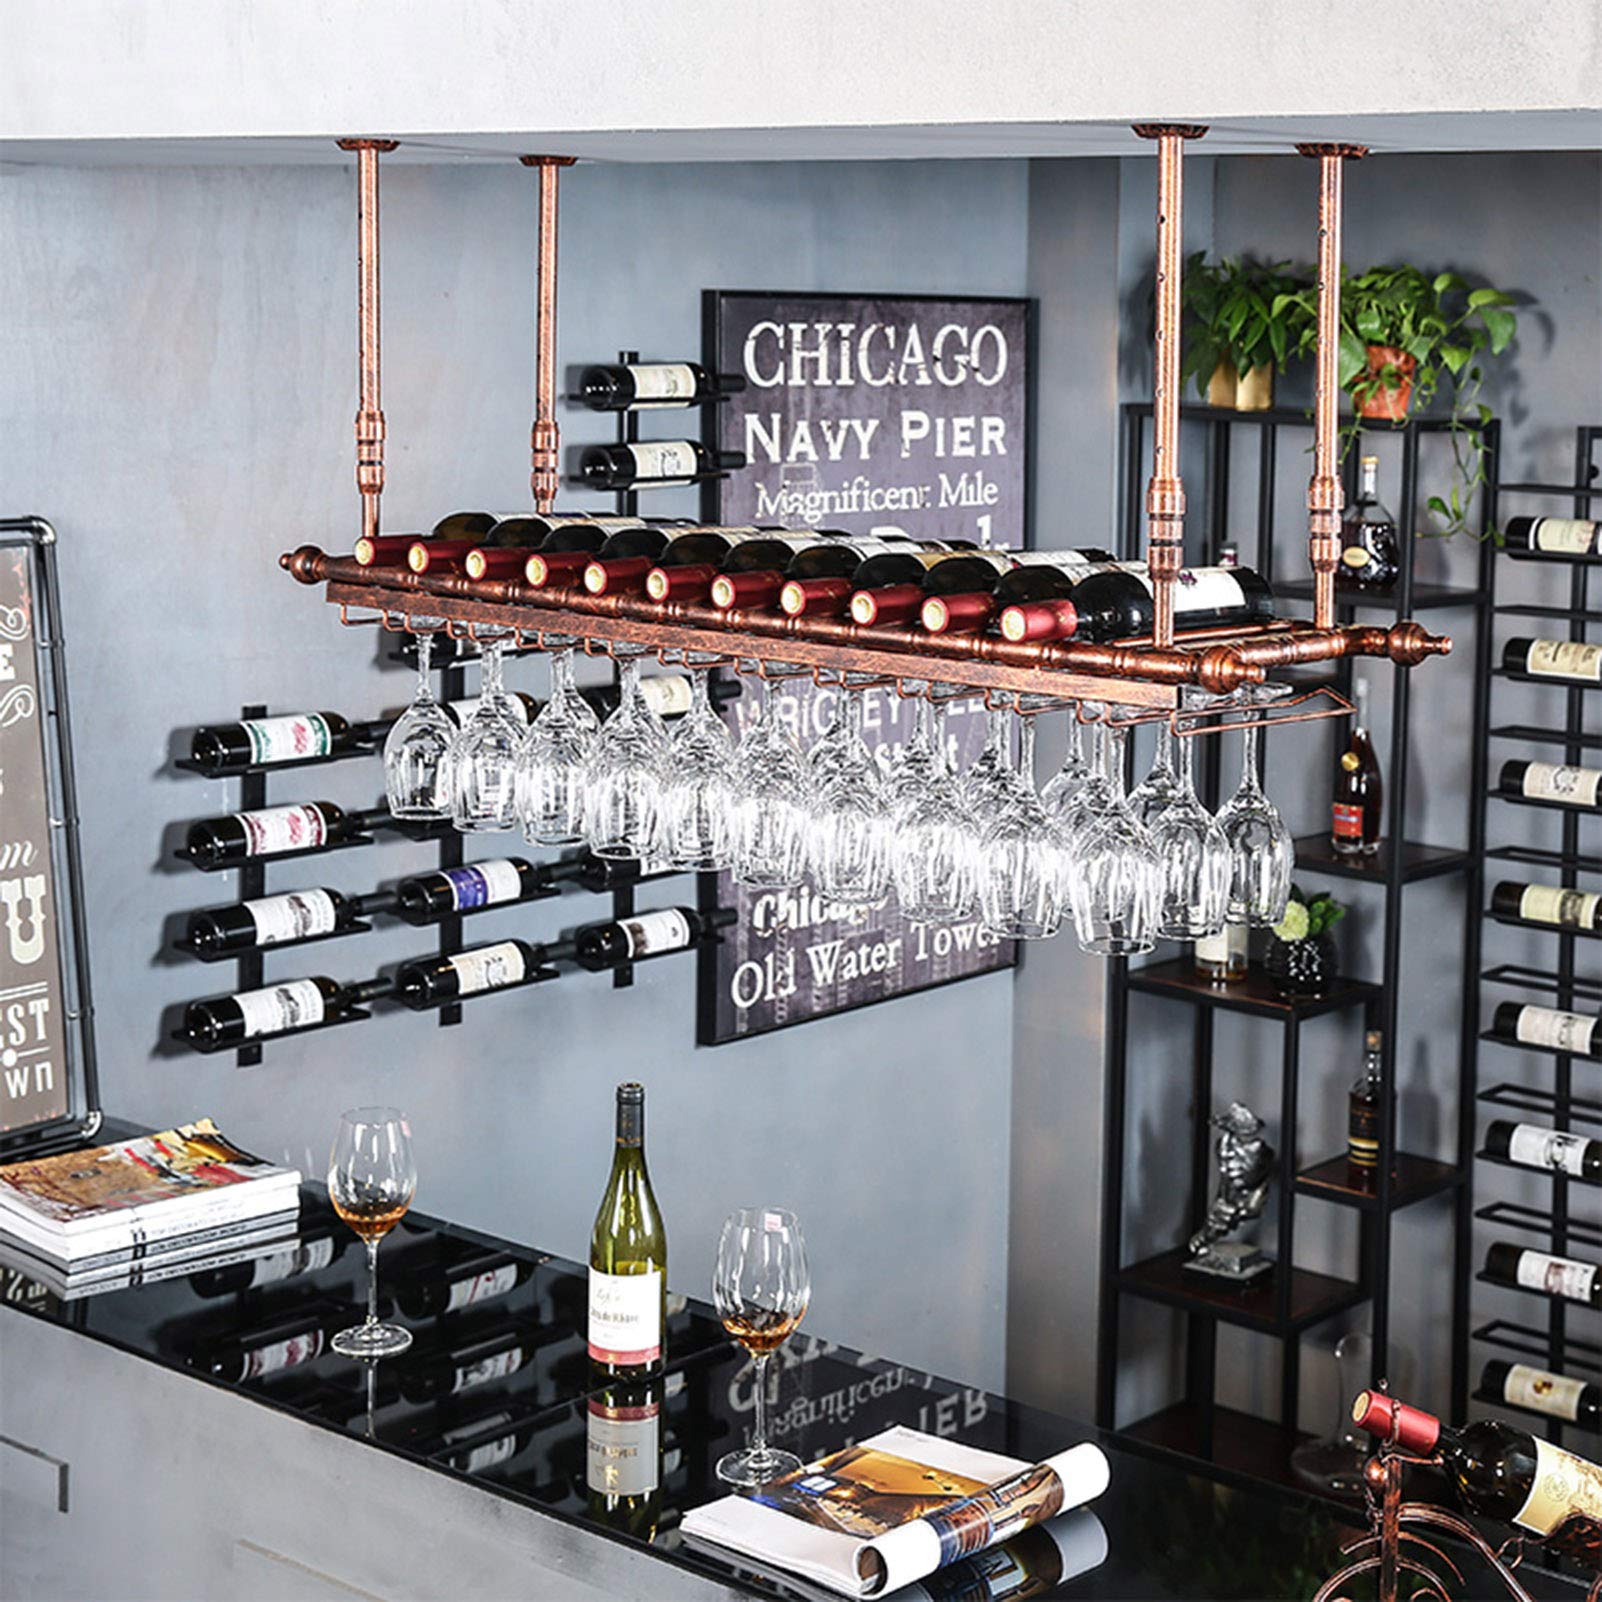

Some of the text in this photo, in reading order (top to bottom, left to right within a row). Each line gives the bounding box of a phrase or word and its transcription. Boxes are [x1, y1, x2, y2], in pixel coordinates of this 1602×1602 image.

[743, 321, 1008, 387] CHICAGO
[744, 413, 879, 464] NAVY
[900, 410, 1007, 459] PIER
[938, 470, 999, 507] Mile
[731, 947, 798, 1008] Old
[805, 939, 902, 988] Water
